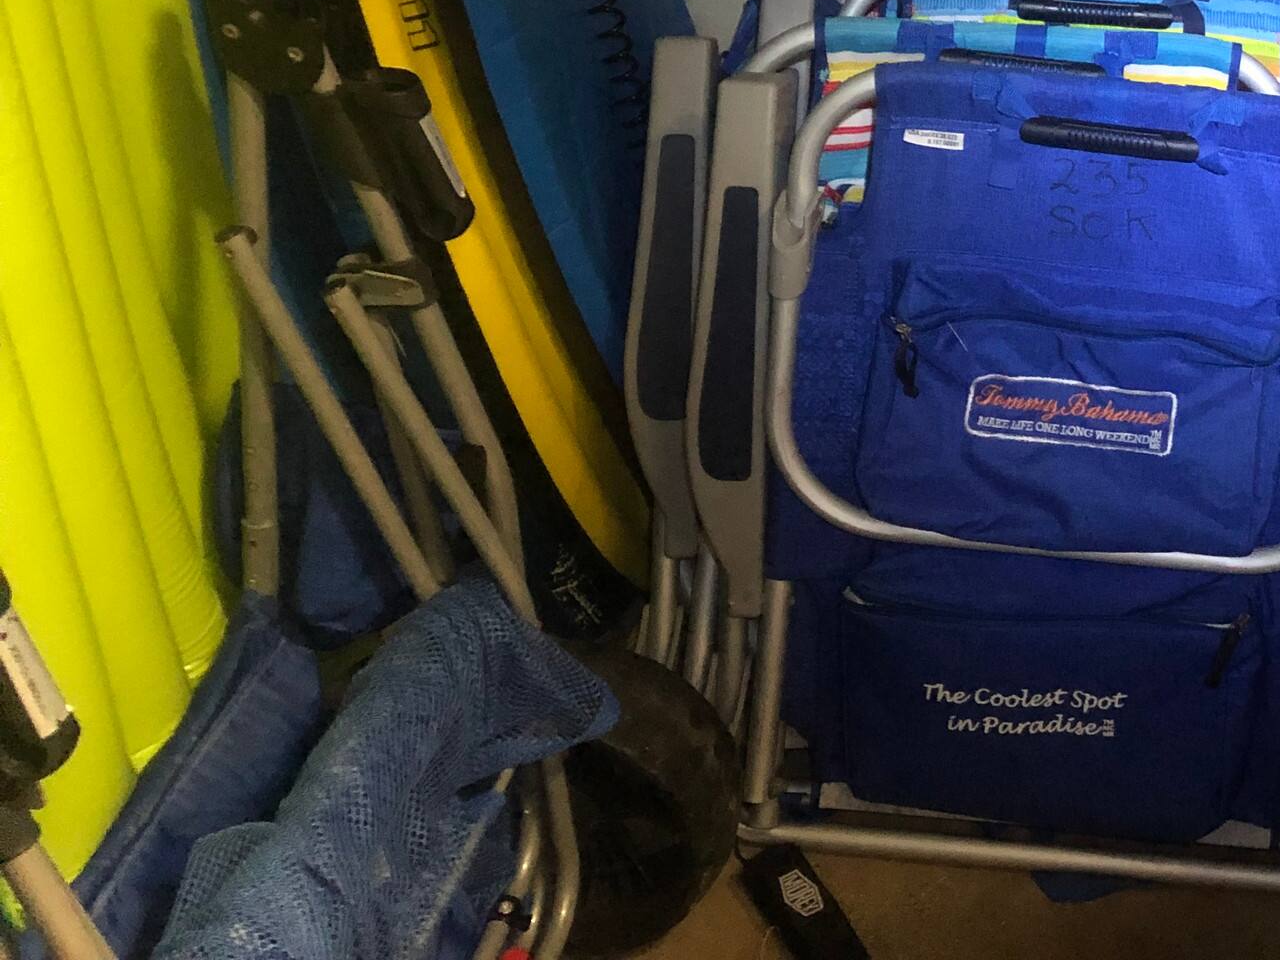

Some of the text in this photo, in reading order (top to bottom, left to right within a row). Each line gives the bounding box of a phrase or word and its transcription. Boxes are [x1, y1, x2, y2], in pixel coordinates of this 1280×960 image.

[1049, 157, 1157, 197] 235
[975, 384, 1169, 425] Tommy Bahama
[977, 416, 1010, 429] MAKE
[1011, 419, 1034, 432] LIFE
[1035, 421, 1059, 434] ONE
[1060, 424, 1094, 438] LONG
[1095, 430, 1151, 444] WEEKEND
[923, 683, 1128, 713] The Coolest Spot
[947, 715, 979, 732] in
[982, 714, 1102, 736] Paradise
